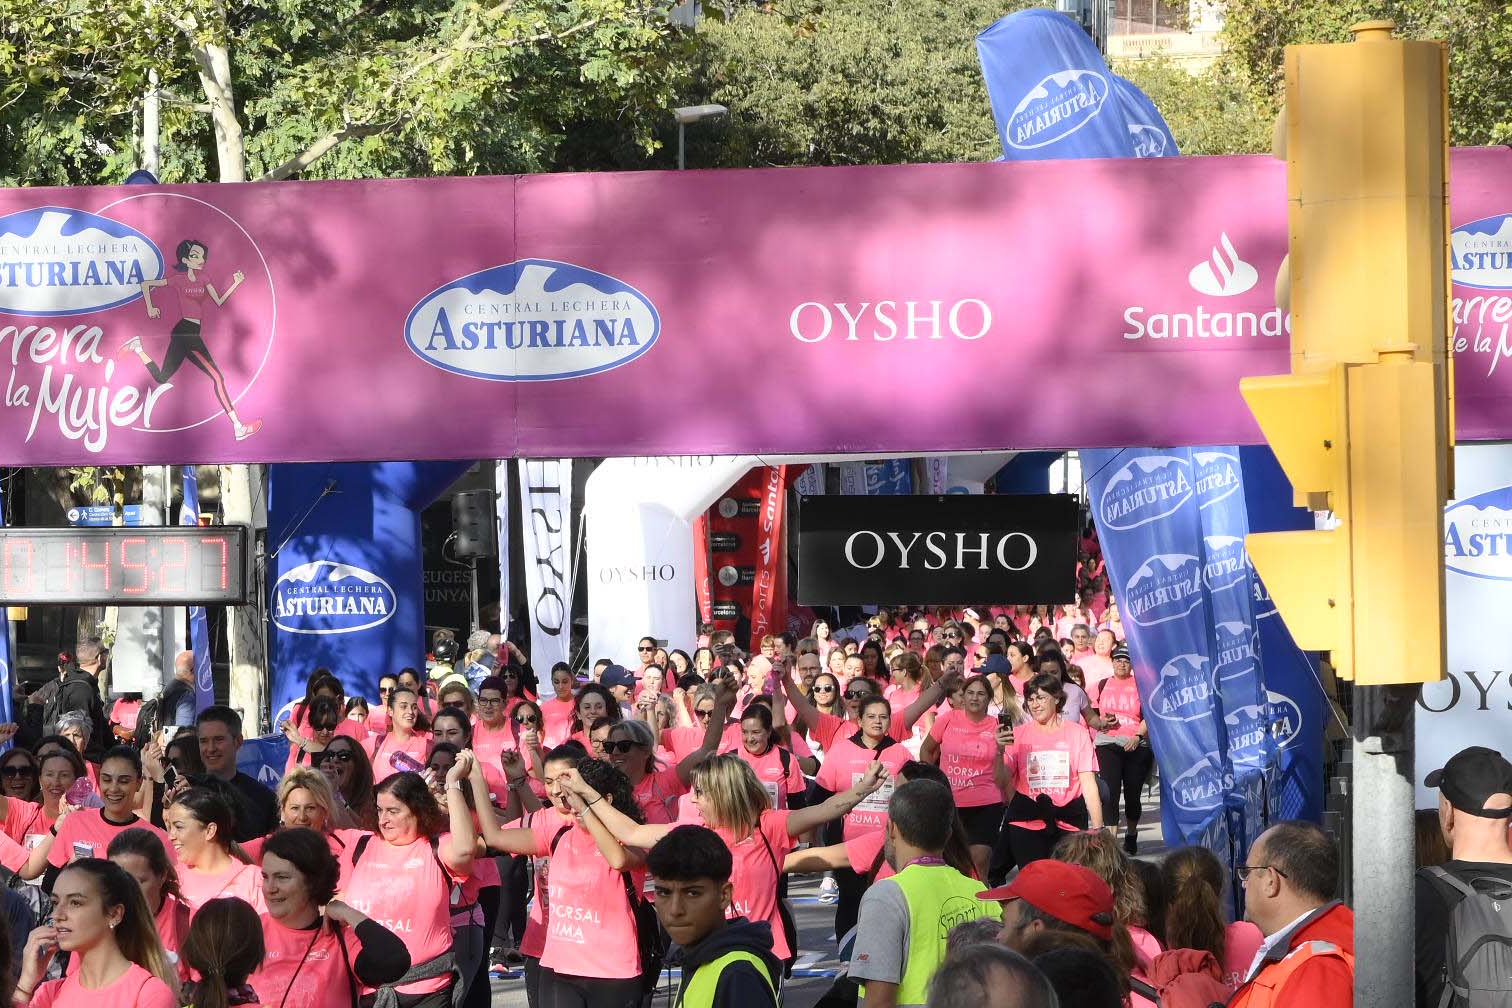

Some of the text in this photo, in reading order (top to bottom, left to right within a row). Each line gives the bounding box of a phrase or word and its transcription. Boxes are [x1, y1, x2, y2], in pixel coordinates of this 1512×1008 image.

[67, 242, 139, 254] LECHERA
[464, 300, 633, 315] CENTRAL LECHERA
[789, 298, 993, 343] OYSHO
[425, 307, 641, 352] ASTURIANA
[1474, 323, 1492, 353] la
[5, 368, 30, 407] la
[25, 359, 174, 453] Mujer
[844, 529, 1038, 571] OYSHO
[600, 563, 676, 583] OYSHO
[276, 589, 387, 618] ASTURIANA
[287, 585, 383, 595] CENTRAL LECHERA
[850, 812, 882, 826] SUMA
